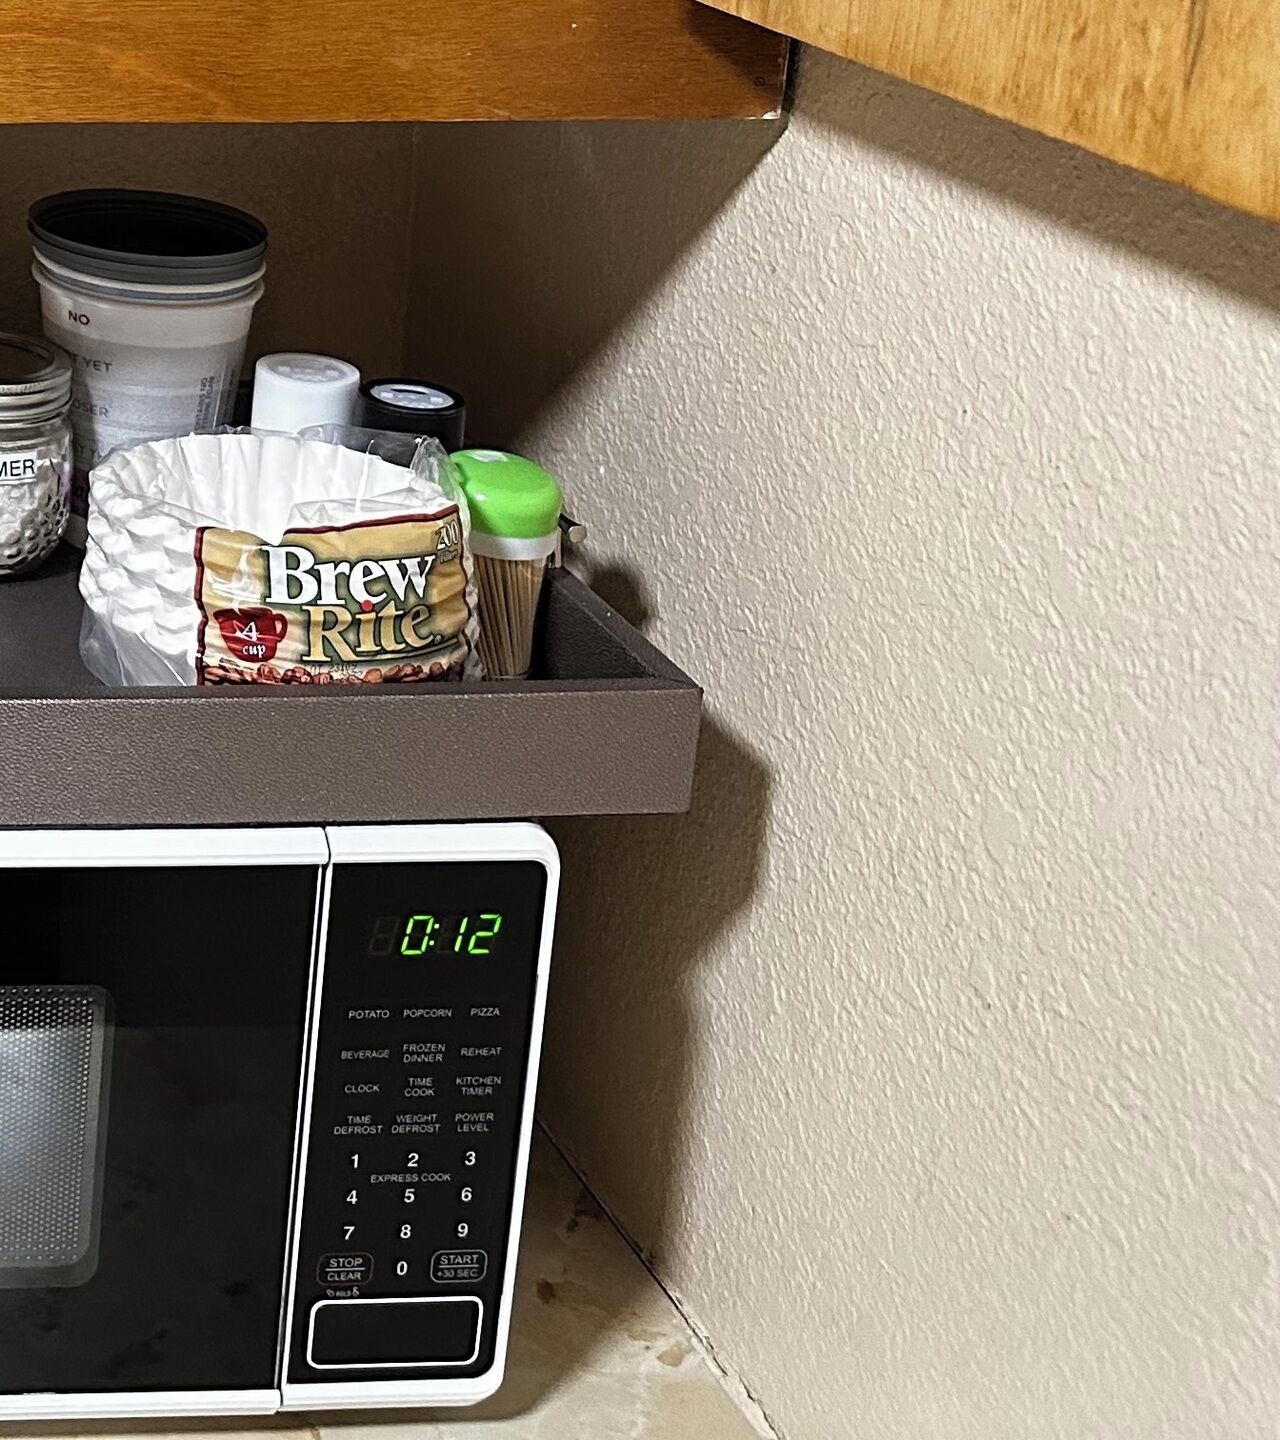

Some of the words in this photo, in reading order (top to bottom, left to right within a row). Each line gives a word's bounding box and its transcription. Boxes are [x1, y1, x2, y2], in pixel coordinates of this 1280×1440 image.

[68, 310, 90, 326] NO
[85, 357, 113, 374] YET
[72, 398, 110, 418] OSER
[260, 544, 437, 605] Brew
[242, 644, 267, 659] cup
[401, 912, 502, 956] 0:12
[348, 1009, 391, 1020] POTATO
[402, 1008, 453, 1019] POPCORN
[470, 1007, 501, 1018] PIZZA
[402, 1042, 446, 1053] FROZEN
[460, 1046, 503, 1057] REHEAT
[340, 1049, 391, 1060] BEVERAGE
[403, 1053, 443, 1063] DINNER
[407, 1077, 434, 1087] TIME
[455, 1075, 502, 1086] KITCHEN
[344, 1083, 381, 1094] CLOCK
[404, 1087, 436, 1097] COOK
[460, 1086, 494, 1096] TIMER
[346, 1114, 373, 1125] TIME
[395, 1113, 438, 1124] WEIGHT
[454, 1111, 495, 1123] POWER
[333, 1125, 384, 1135] DEFROST
[391, 1123, 441, 1134] DEFROST
[457, 1122, 490, 1133] LEVEL
[351, 1153, 359, 1169] 1
[407, 1152, 420, 1167] 2
[464, 1150, 477, 1166] 3
[370, 1172, 419, 1184] EXPRESS
[421, 1172, 452, 1182] COOK
[346, 1189, 358, 1205] 4
[403, 1188, 416, 1203] 5
[460, 1186, 473, 1202] 6
[343, 1225, 356, 1240] 7
[400, 1224, 412, 1239] 8
[457, 1223, 469, 1238] 9
[329, 1257, 364, 1268] STOP
[439, 1254, 480, 1265] START
[396, 1261, 408, 1276] 0
[437, 1268, 455, 1278] +30
[456, 1267, 479, 1278] SEC
[327, 1271, 362, 1281] CLEAR
